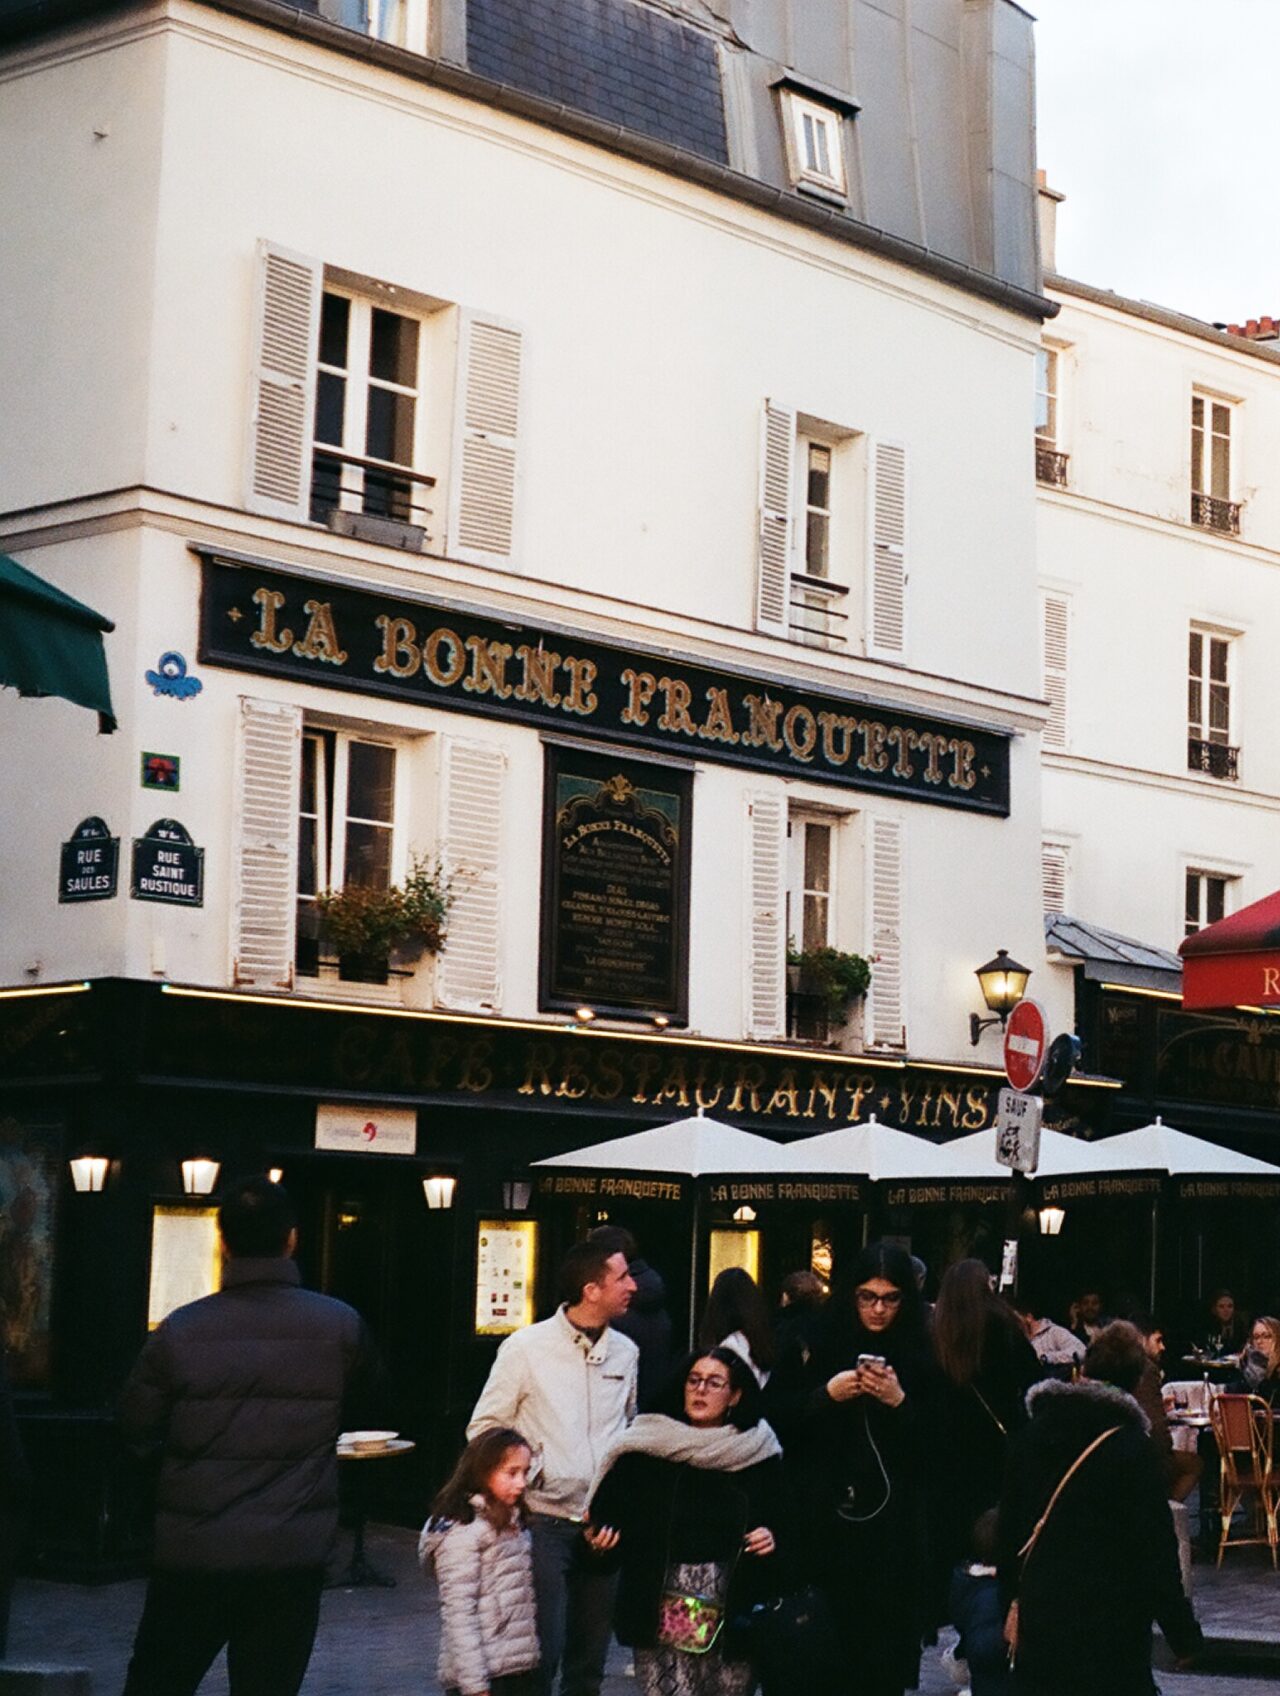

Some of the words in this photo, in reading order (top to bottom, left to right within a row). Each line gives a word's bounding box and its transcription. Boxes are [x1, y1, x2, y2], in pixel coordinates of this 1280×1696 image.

[249, 587, 348, 667] LA
[373, 613, 599, 715] BONNE
[620, 667, 977, 791] FRANQUETTE
[77, 848, 103, 864] RUE
[157, 850, 181, 865] RUE
[152, 864, 185, 880] SAINT
[66, 875, 111, 892] SAULES
[140, 878, 196, 897] RUSTIQUE
[517, 1038, 877, 1121] RESTAURANT
[899, 1076, 990, 1130] VINS
[1005, 1096, 1028, 1118] SAUF
[555, 1177, 597, 1194] BONNE
[600, 1178, 682, 1200] FRANQUETTE
[709, 1185, 728, 1201] LA
[730, 1184, 775, 1200] BONNE
[778, 1182, 860, 1201] FRANQUETTE
[888, 1188, 906, 1205] LA
[908, 1187, 947, 1204] BONNE
[1043, 1183, 1060, 1200] LA
[1061, 1181, 1097, 1197] BONNE
[1098, 1178, 1163, 1198] FRANQUETTE
[1198, 1182, 1228, 1197] BONNE
